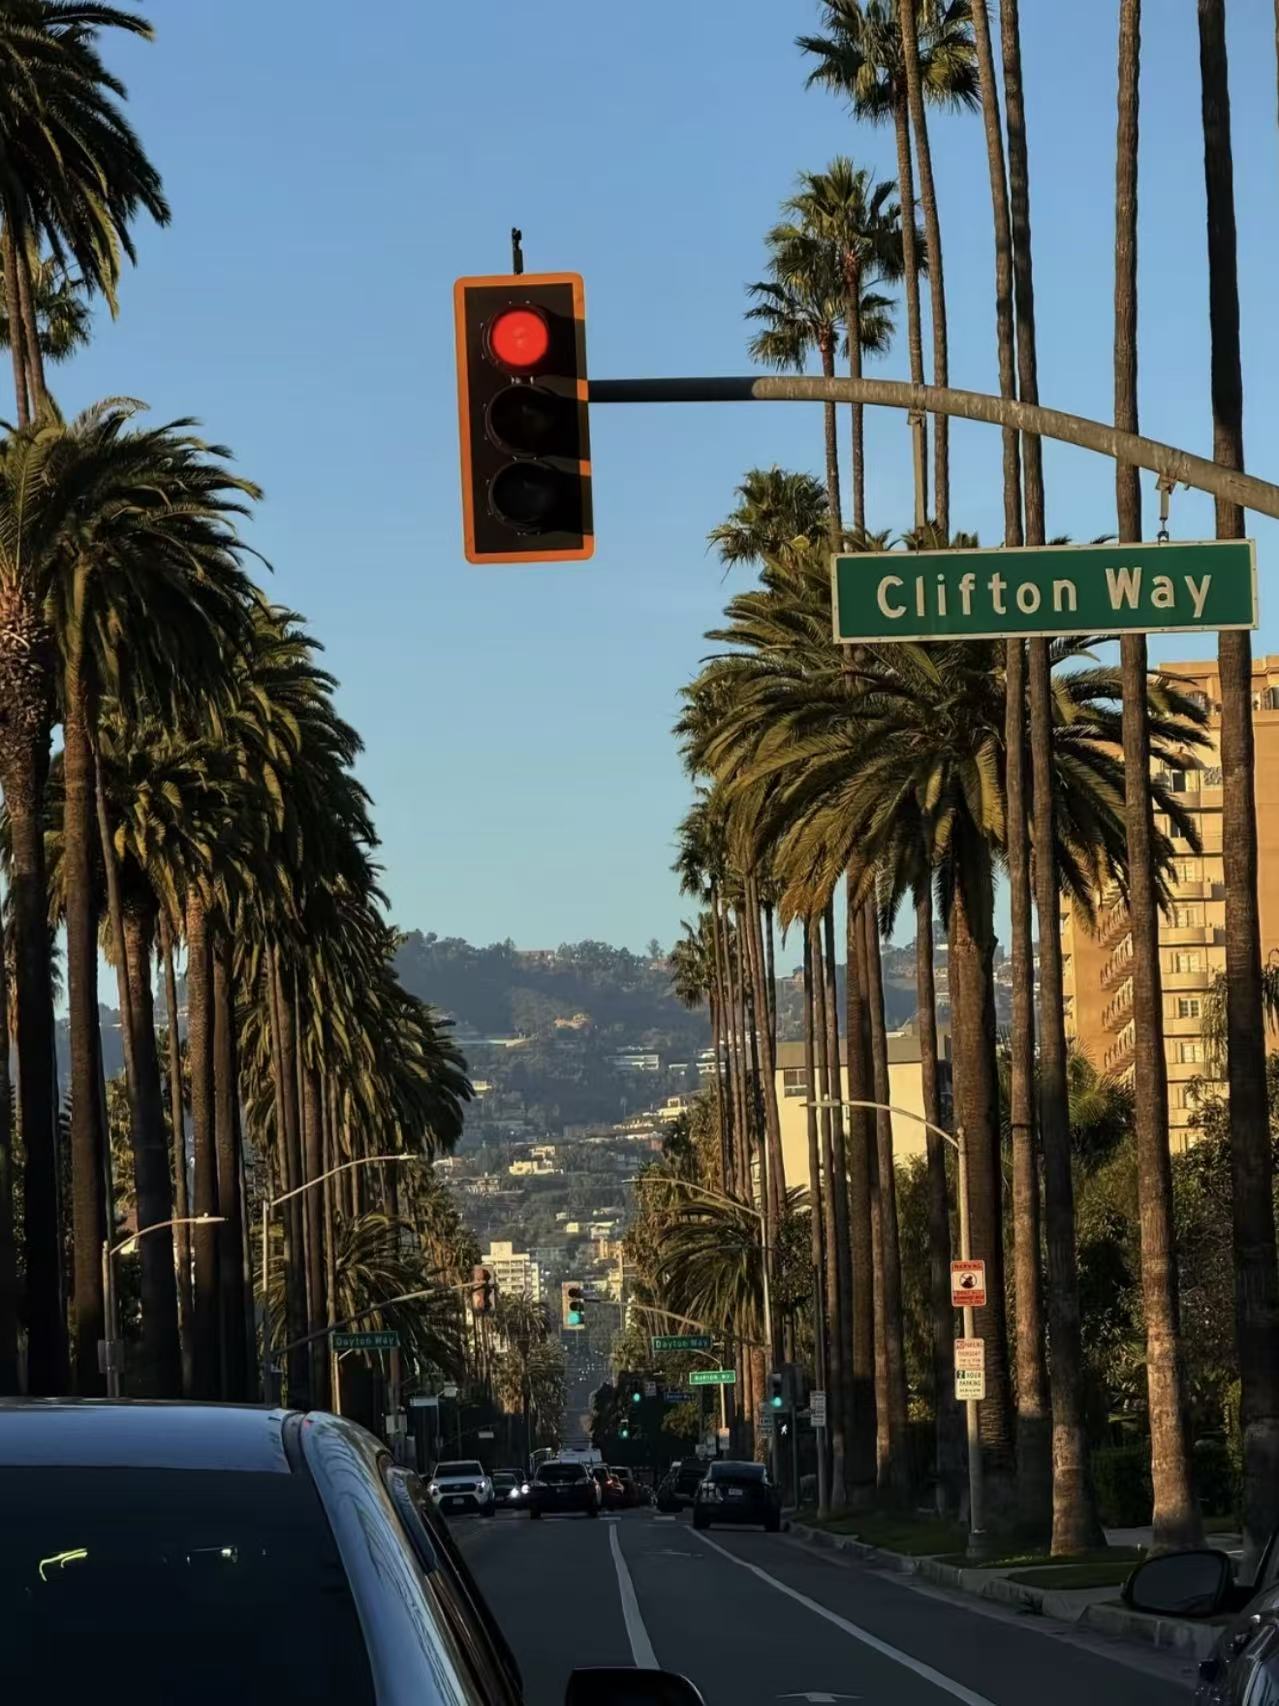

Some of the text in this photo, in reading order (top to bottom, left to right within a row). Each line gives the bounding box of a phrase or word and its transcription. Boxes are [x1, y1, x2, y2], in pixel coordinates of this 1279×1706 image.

[877, 567, 1212, 618] Clifton Way
[655, 1339, 688, 1350] Dayton
